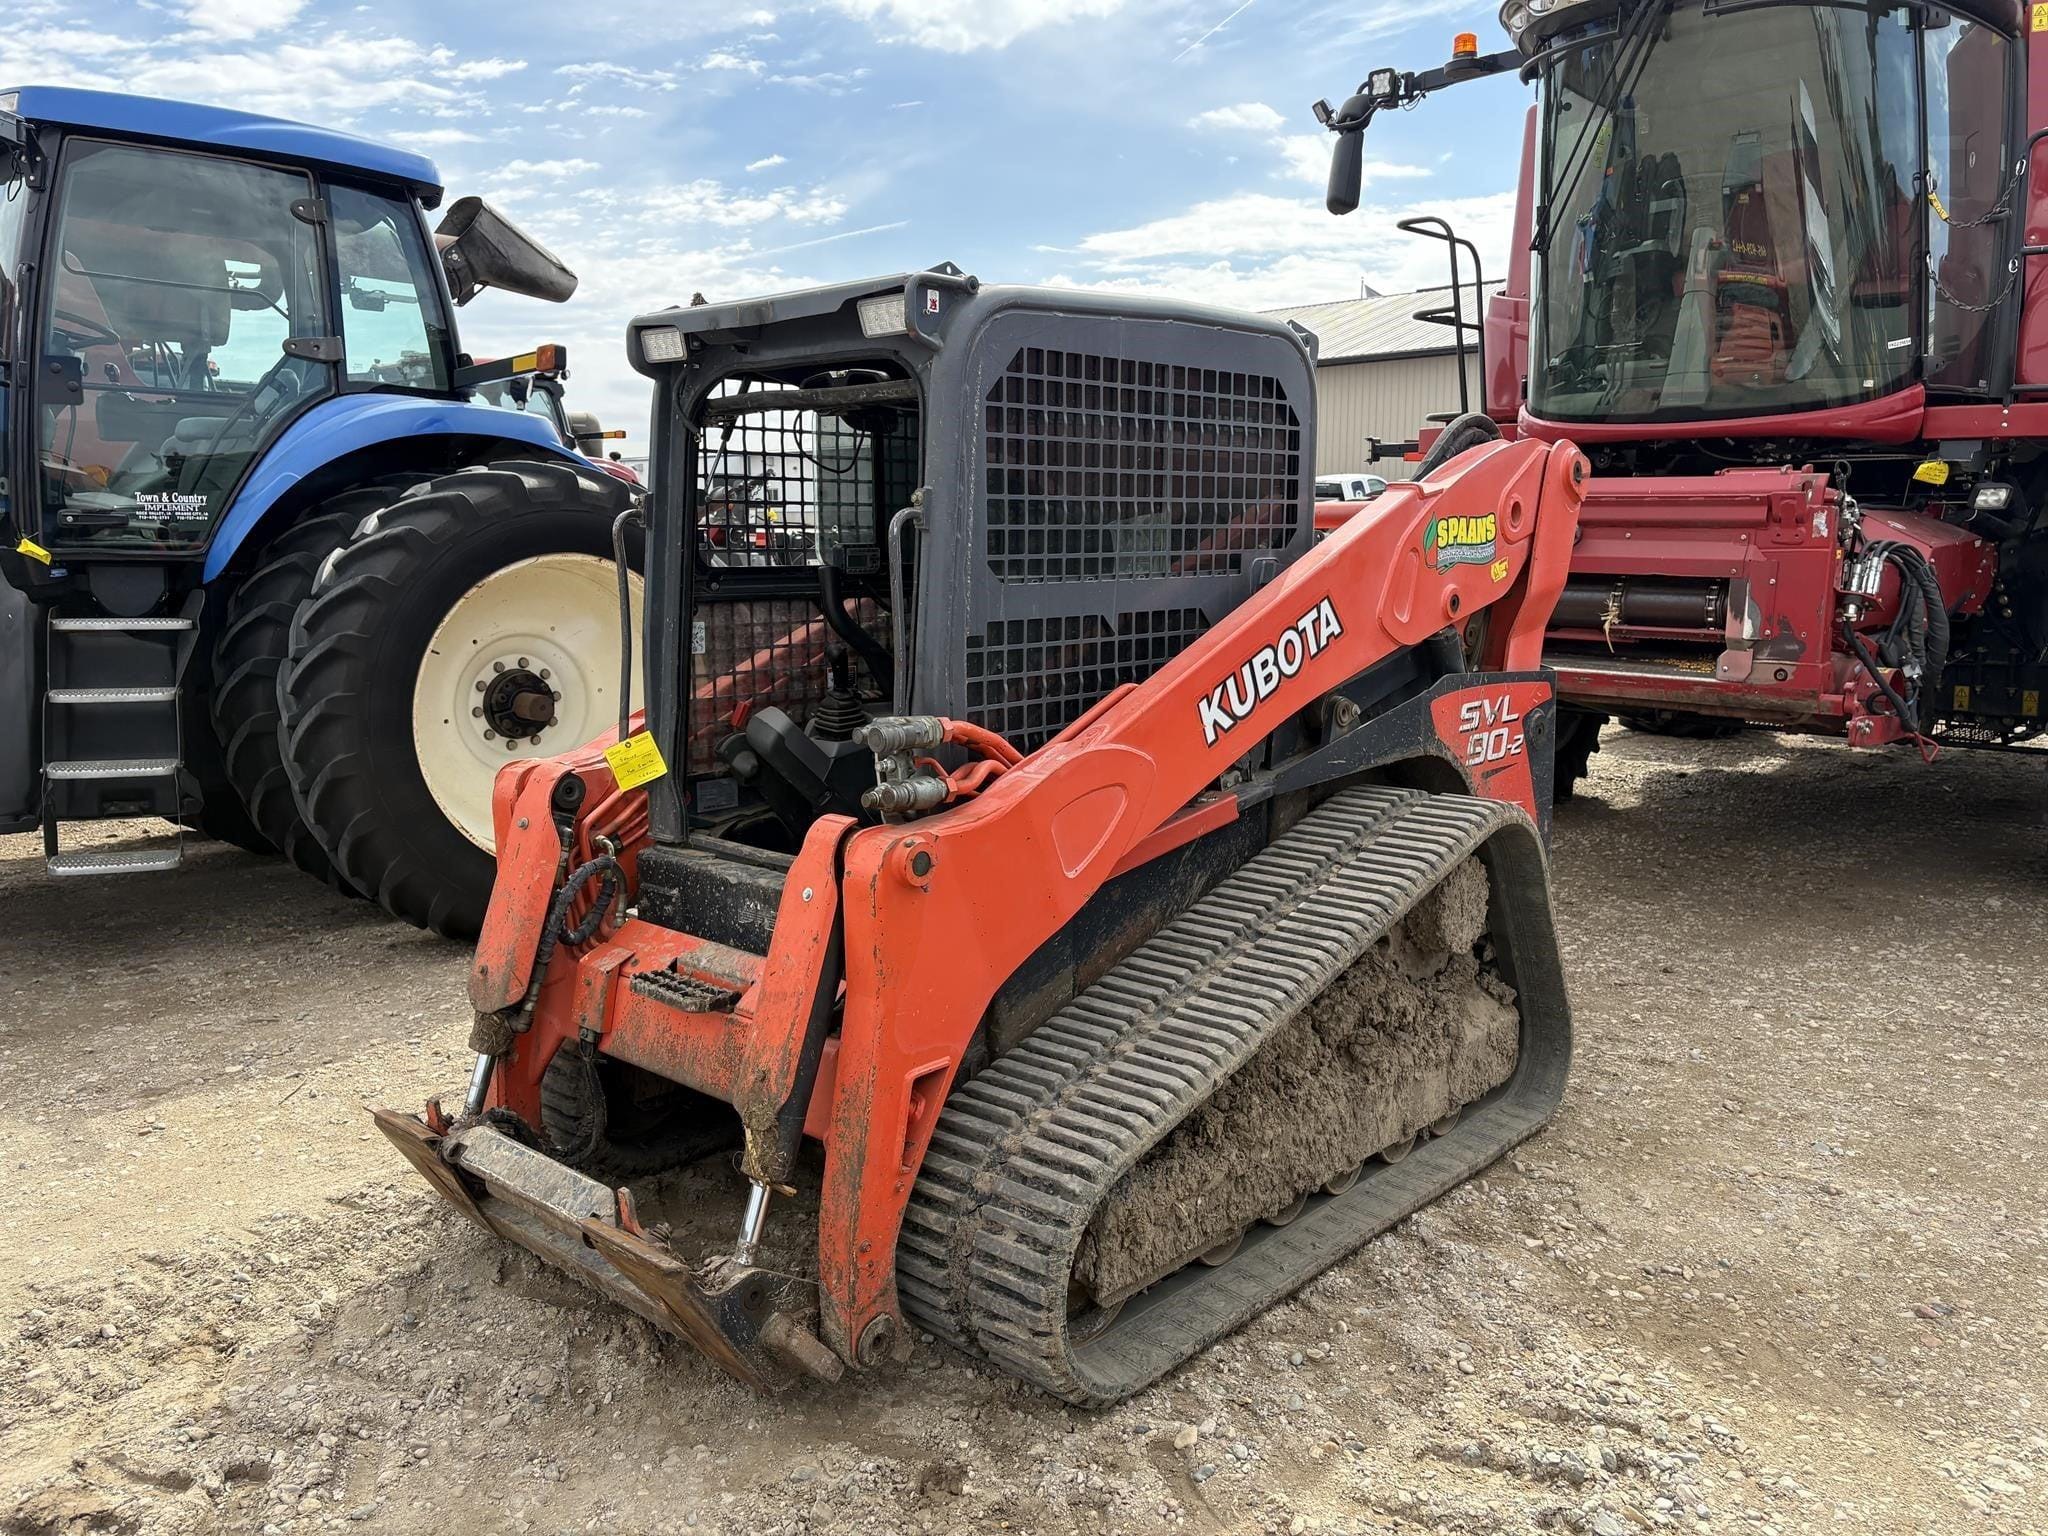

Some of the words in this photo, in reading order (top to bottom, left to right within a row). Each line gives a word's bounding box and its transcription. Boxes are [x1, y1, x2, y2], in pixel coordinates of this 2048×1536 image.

[134, 491, 159, 502] Town
[161, 491, 170, 503] &
[171, 492, 208, 505] Country
[144, 504, 199, 512] IMPLEMENT
[1437, 513, 1497, 549] SPAANS
[1198, 597, 1343, 746] KUBOTA
[1459, 695, 1519, 733] SVL
